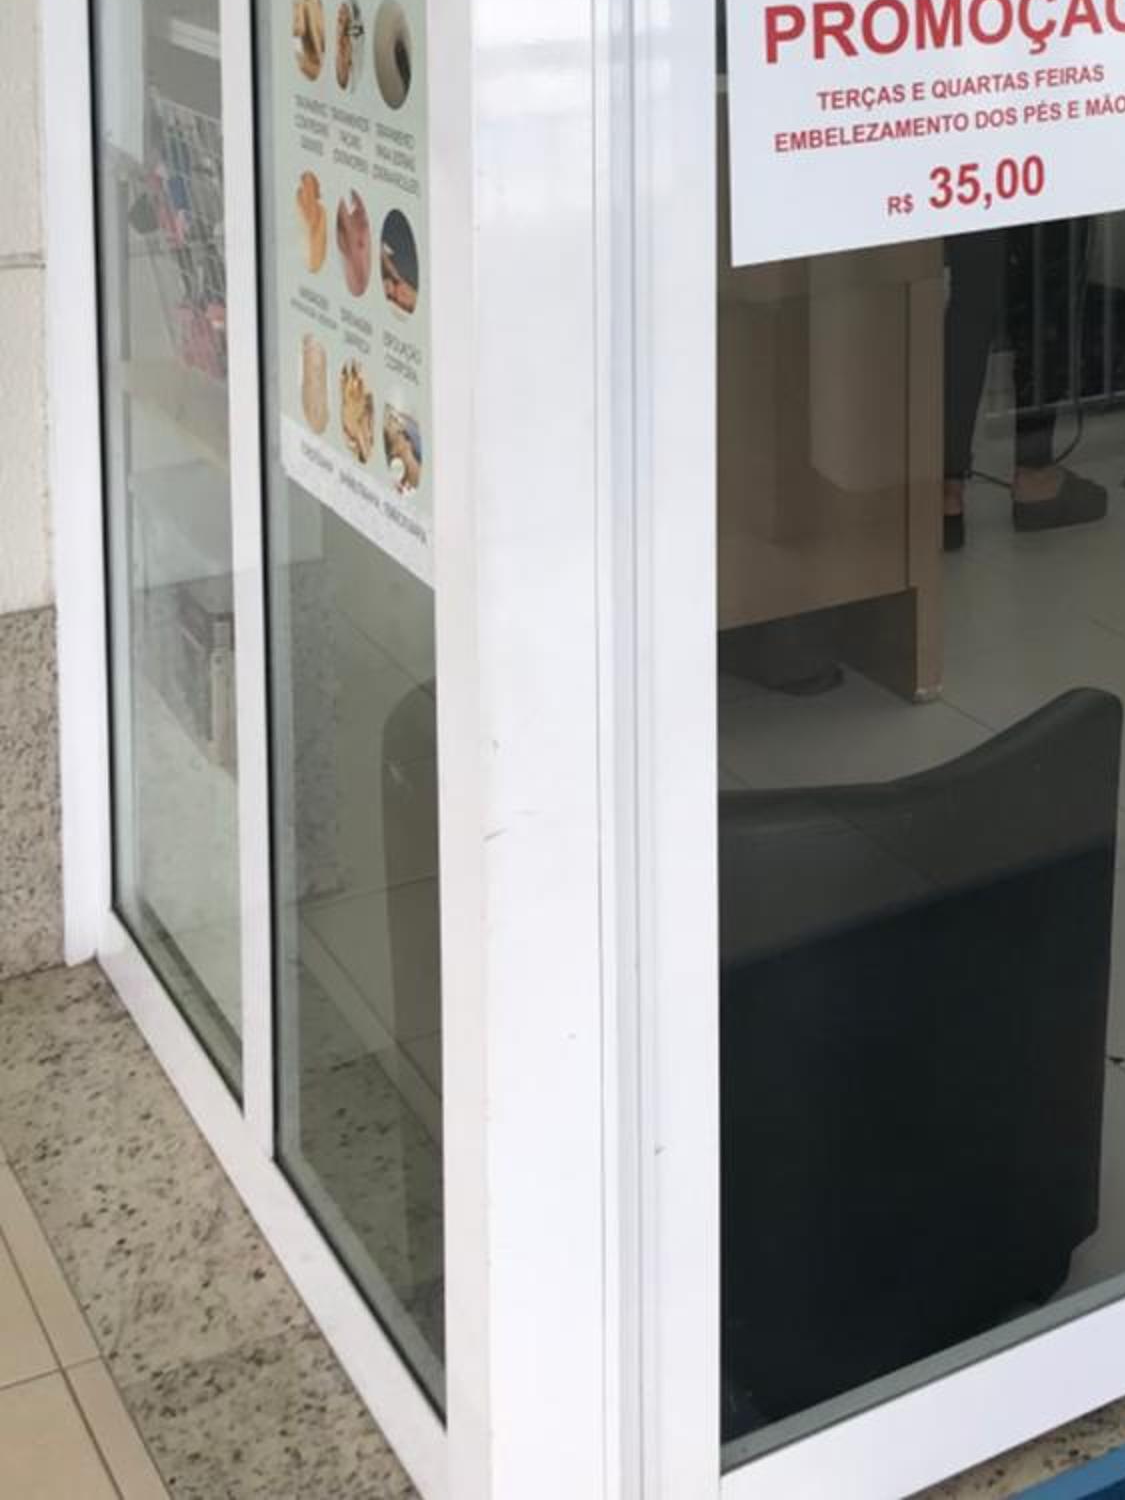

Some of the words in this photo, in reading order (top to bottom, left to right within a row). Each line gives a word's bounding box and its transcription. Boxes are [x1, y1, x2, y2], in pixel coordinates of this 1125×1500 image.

[817, 81, 906, 112] TERÇAS
[913, 82, 926, 101] E
[931, 71, 1030, 100] QUARTAS
[1035, 64, 1105, 88] FEIRAS
[774, 112, 969, 153] EMBELEZAMENTO
[975, 108, 1018, 130] DOS
[1023, 98, 1062, 123] PÉS
[1068, 100, 1080, 119] E
[887, 193, 914, 217] R$
[928, 154, 1045, 210] 35,00
